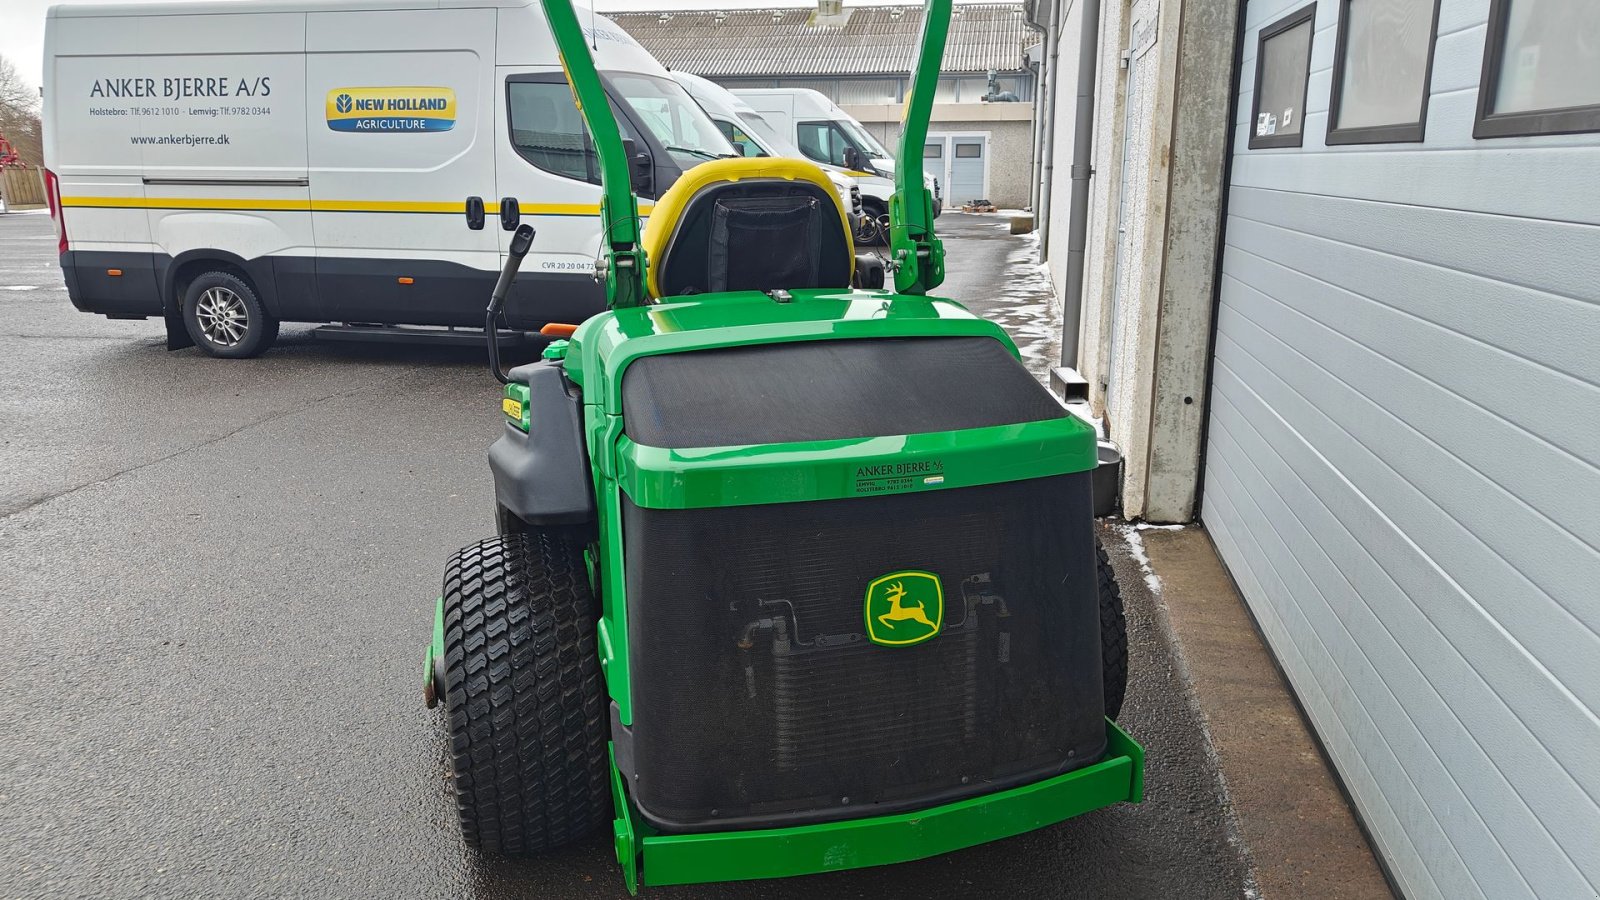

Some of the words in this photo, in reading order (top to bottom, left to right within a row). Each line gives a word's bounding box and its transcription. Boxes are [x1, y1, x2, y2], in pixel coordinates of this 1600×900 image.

[90, 78, 157, 97] ANKER
[163, 77, 229, 101] BJERRE
[235, 77, 271, 97] A/S
[355, 98, 385, 110] NEW
[388, 98, 447, 110] HOLLAND
[89, 107, 128, 116] Holstebro:
[142, 107, 159, 116] 9612
[162, 107, 179, 116] 1010
[188, 106, 219, 118] Lemvig:
[232, 106, 250, 116] 9782
[251, 106, 271, 116] 0344
[356, 119, 426, 129] AGRICULTURE
[130, 133, 230, 148] www.ankerbjerre.dk
[856, 465, 894, 478] ANKER
[896, 461, 931, 475] BJERRE
